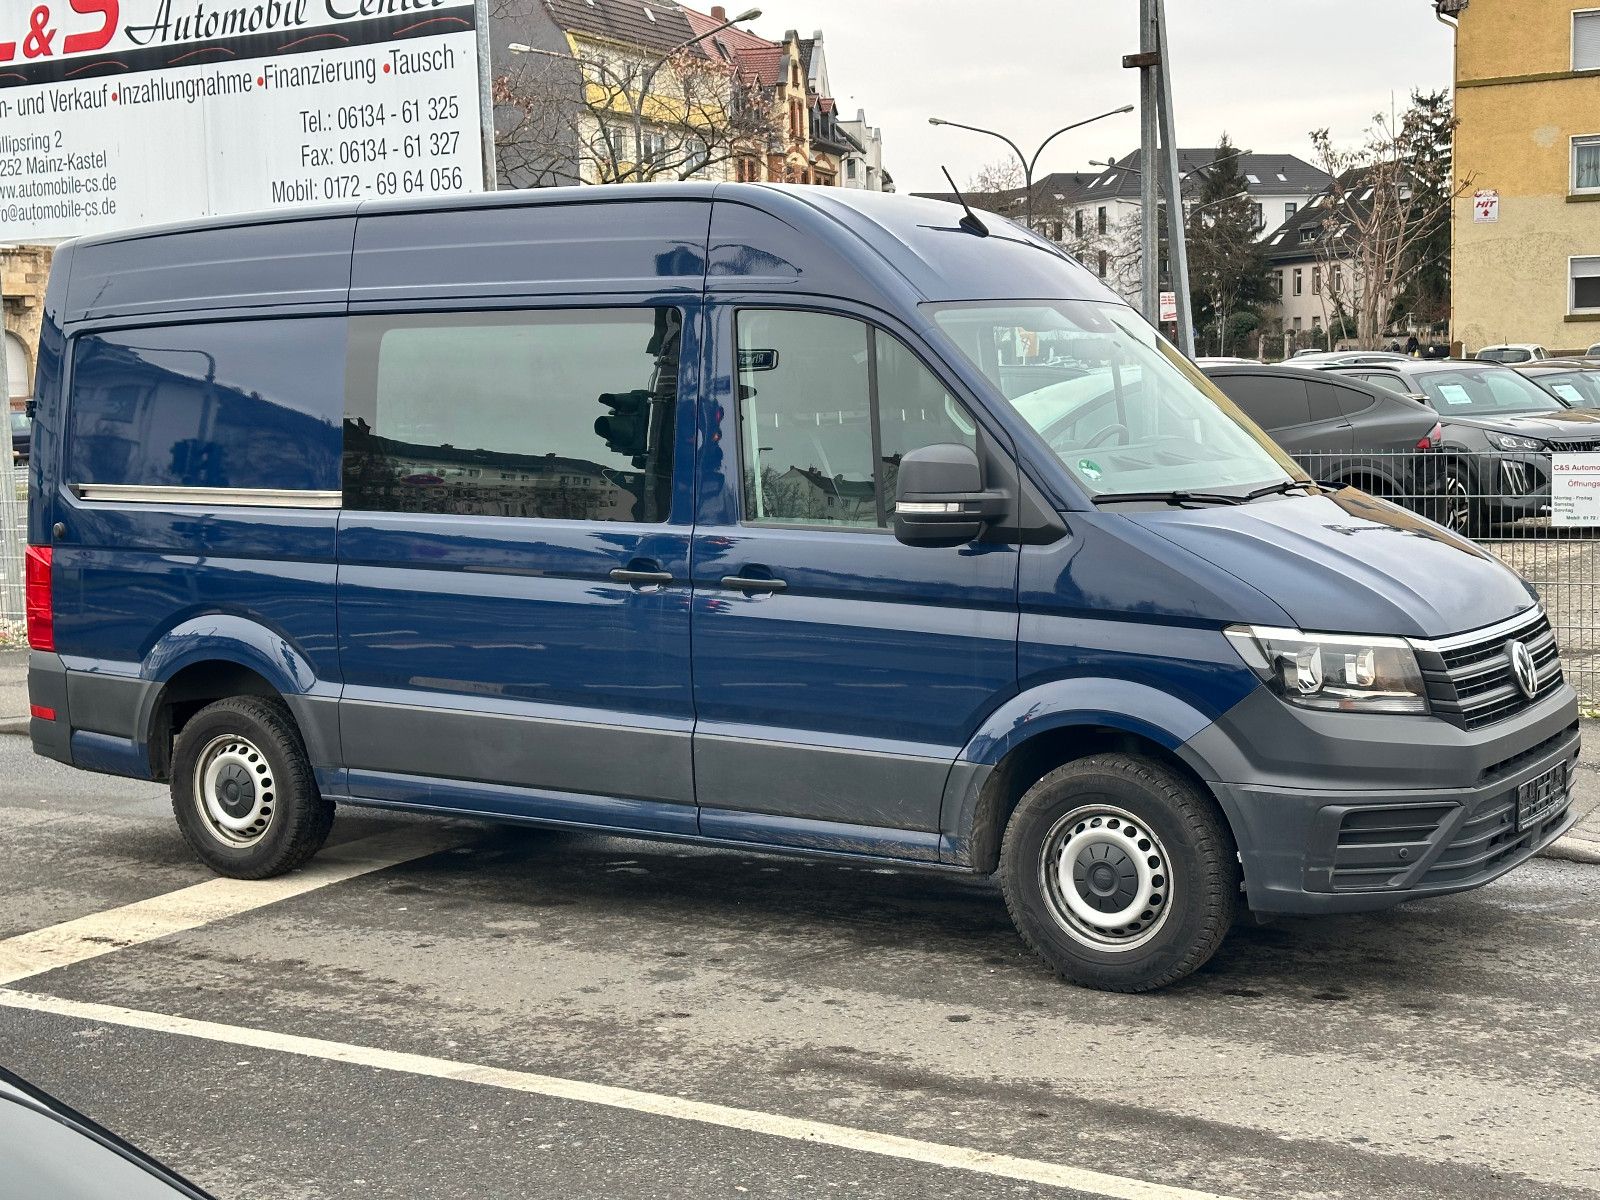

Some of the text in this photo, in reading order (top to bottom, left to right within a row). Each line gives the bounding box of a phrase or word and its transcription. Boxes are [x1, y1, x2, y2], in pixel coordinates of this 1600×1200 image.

[0, 0, 119, 62] &S
[124, 0, 308, 46] Automobil
[18, 91, 45, 116] und
[49, 83, 108, 113] Verkauf
[118, 70, 252, 106] Inzahlungnahme
[264, 57, 376, 90] Finanzierung
[389, 43, 455, 76] Tausch
[299, 109, 332, 133] Tel.:
[337, 103, 386, 130] 06134
[402, 98, 420, 124] 61
[428, 95, 459, 121] 325
[54, 130, 63, 148] 2
[301, 144, 334, 167] Fax:
[339, 137, 388, 164] 06134
[403, 134, 422, 158] 61
[429, 131, 460, 156] 327
[26, 149, 107, 175] Mainz-Kastel
[271, 179, 318, 203] Mobil:
[323, 174, 361, 199] 0172
[376, 171, 397, 195] 69
[403, 169, 424, 193] 64
[430, 166, 463, 191] 056
[1476, 200, 1497, 208] HIT
